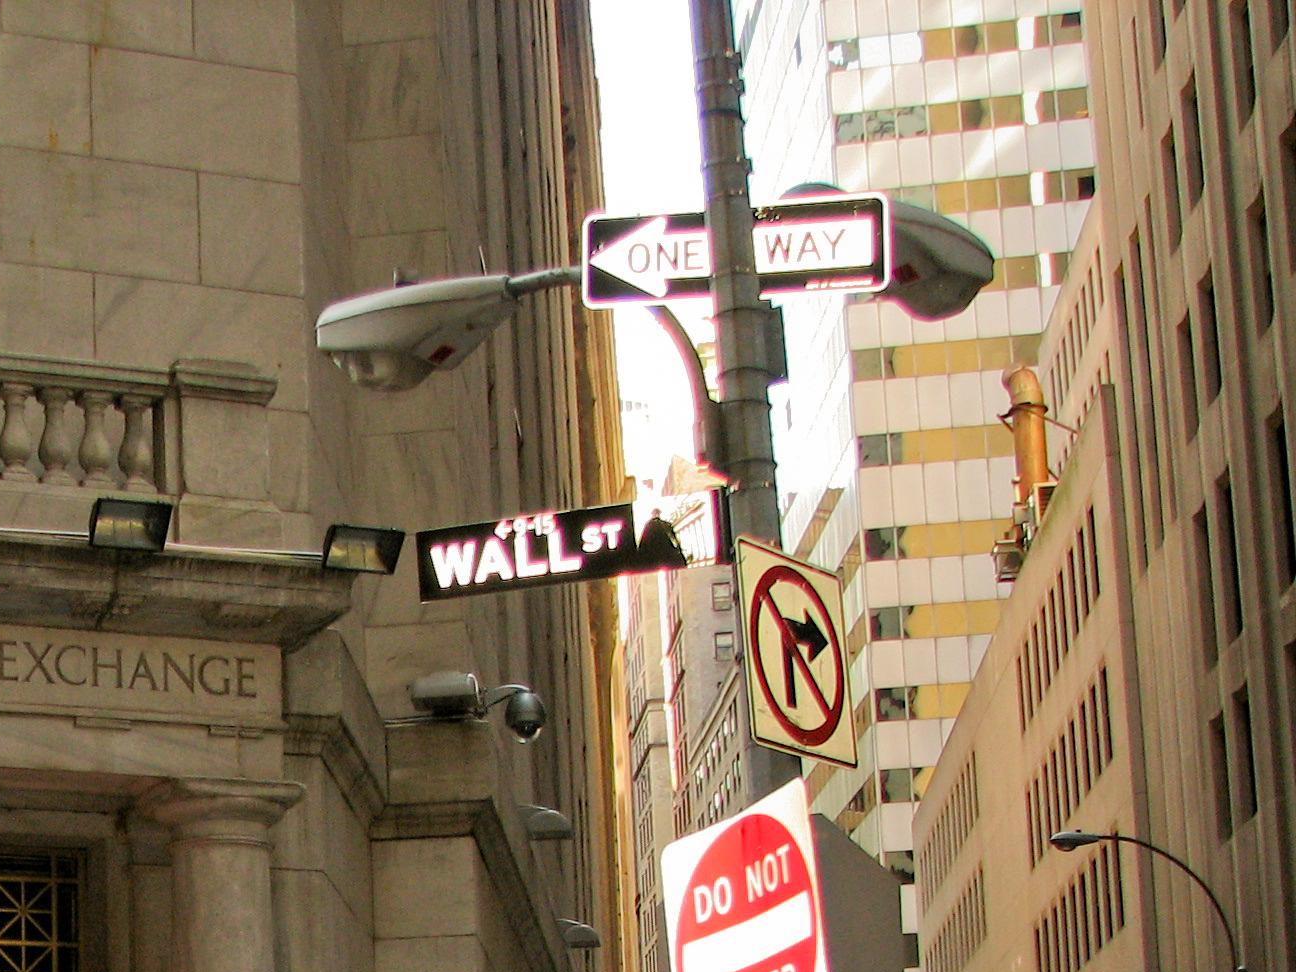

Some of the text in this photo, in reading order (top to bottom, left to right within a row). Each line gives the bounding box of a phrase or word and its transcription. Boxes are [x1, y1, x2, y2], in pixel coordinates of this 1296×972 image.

[626, 228, 846, 275] ONE WAY
[429, 519, 623, 589] WALL ST
[512, 514, 556, 537] 9-15
[693, 843, 791, 924] DO NOT
